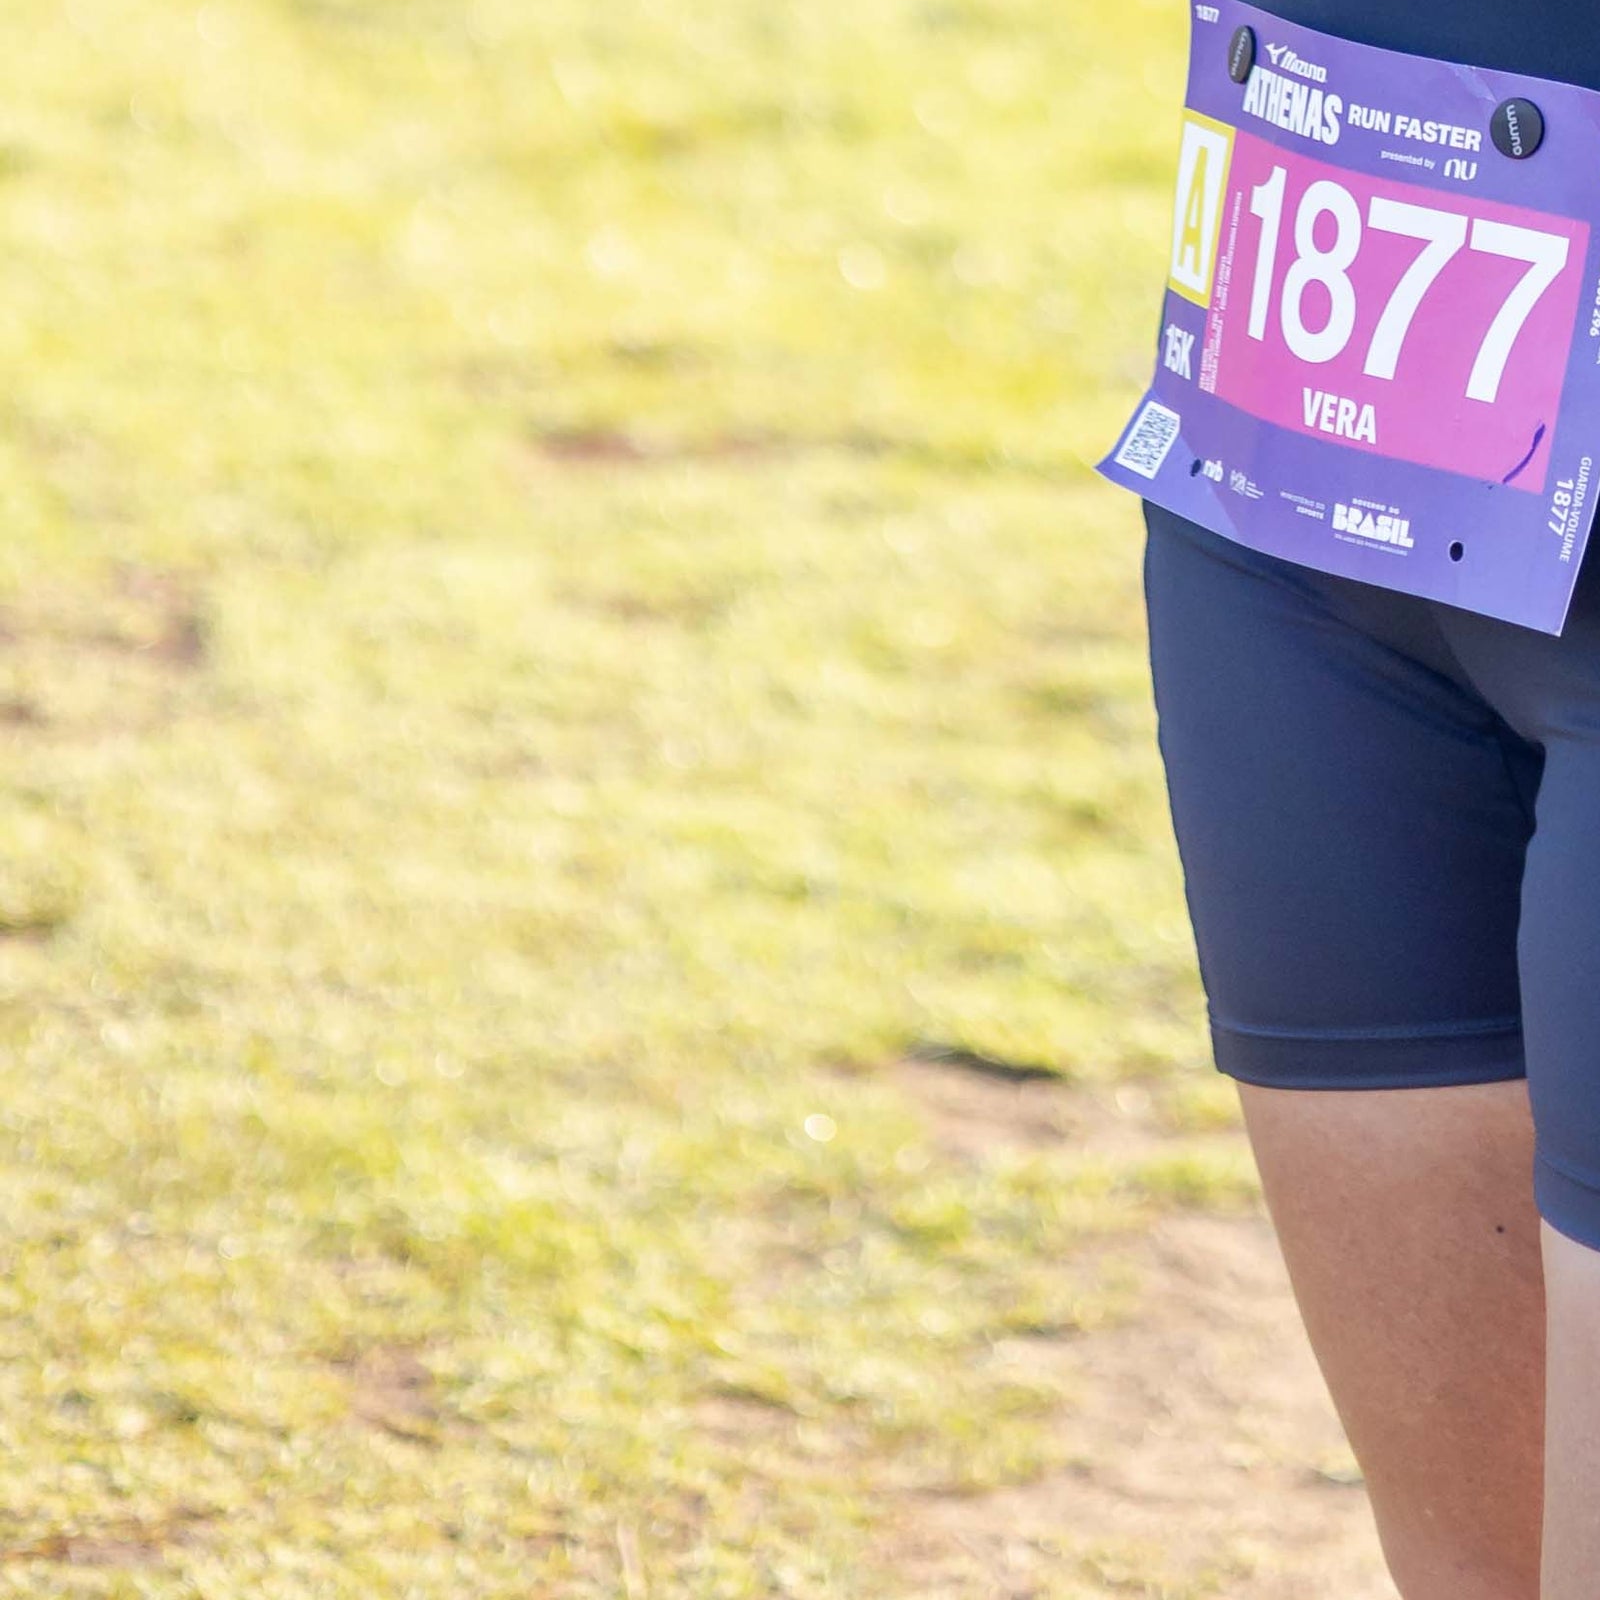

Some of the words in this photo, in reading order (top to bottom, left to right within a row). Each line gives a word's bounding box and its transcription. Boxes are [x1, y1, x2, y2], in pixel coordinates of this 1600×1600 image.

[1242, 64, 1343, 146] ATHENAS
[1348, 103, 1392, 134] RUN
[1394, 115, 1483, 153] FASTER
[1380, 150, 1424, 167] presented
[1424, 157, 1436, 170] by
[1177, 145, 1209, 277] A
[1248, 165, 1571, 403] 1877
[1163, 323, 1195, 380] 15K
[1302, 387, 1377, 445] VERA
[1331, 502, 1414, 548] BRASIL
[1548, 479, 1574, 537] 1877
[1559, 456, 1592, 563] GUARDA-VOLUME
